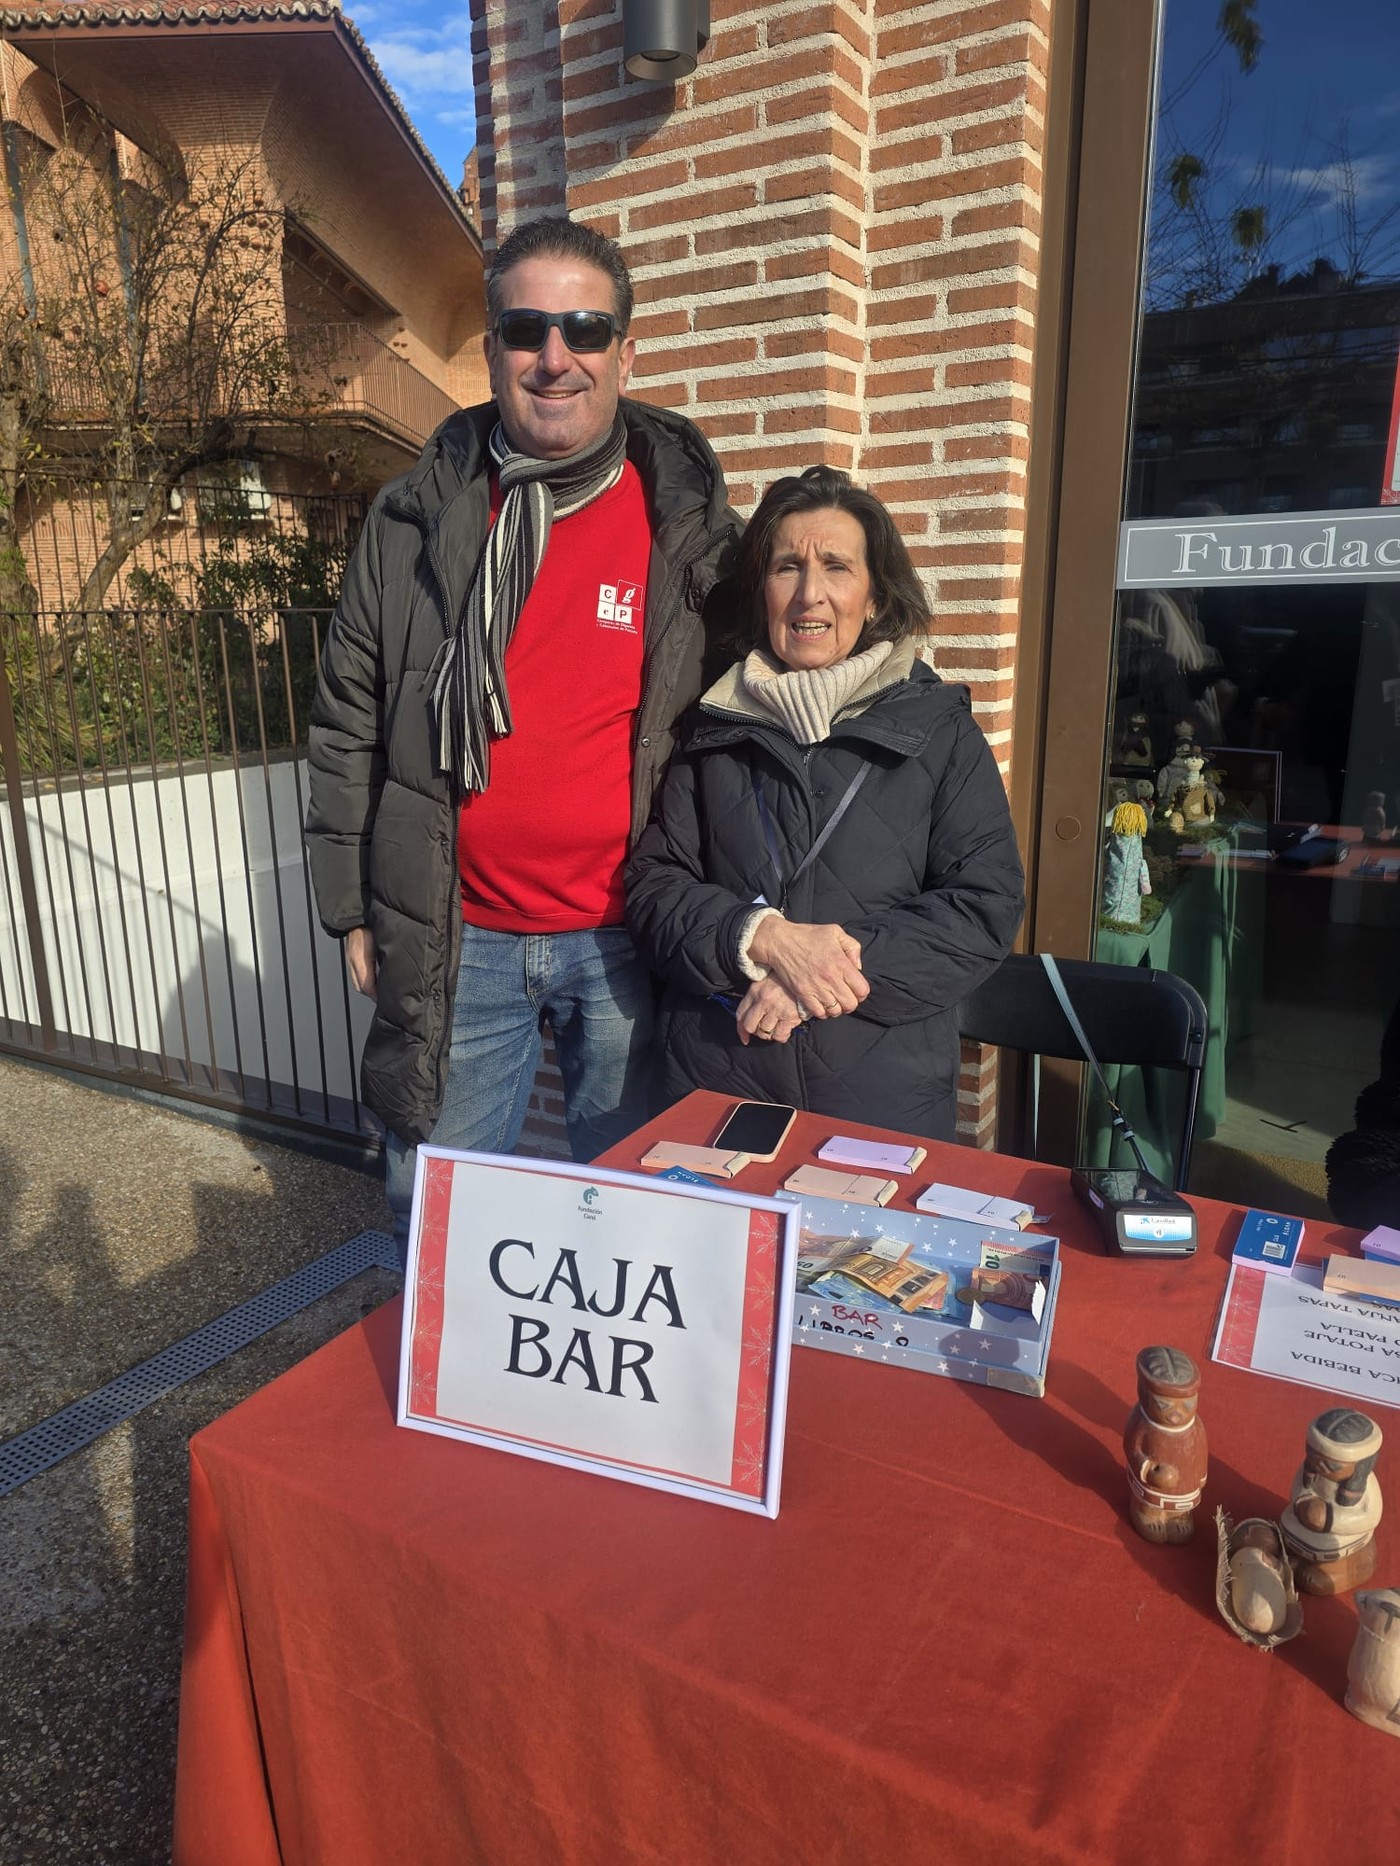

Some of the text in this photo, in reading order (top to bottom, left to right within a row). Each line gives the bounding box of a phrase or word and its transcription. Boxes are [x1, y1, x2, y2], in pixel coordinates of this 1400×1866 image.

[1172, 526, 1400, 573] Fundac
[985, 1254, 1000, 1269] 10
[489, 1238, 687, 1329] CAJA
[1298, 1296, 1353, 1313] TAPAS
[831, 1305, 883, 1330] BAR
[1304, 1330, 1374, 1353] POTAJE
[1320, 1322, 1387, 1343] PAELLA
[503, 1313, 660, 1403] BAR
[1291, 1351, 1361, 1375] BEBIDA
